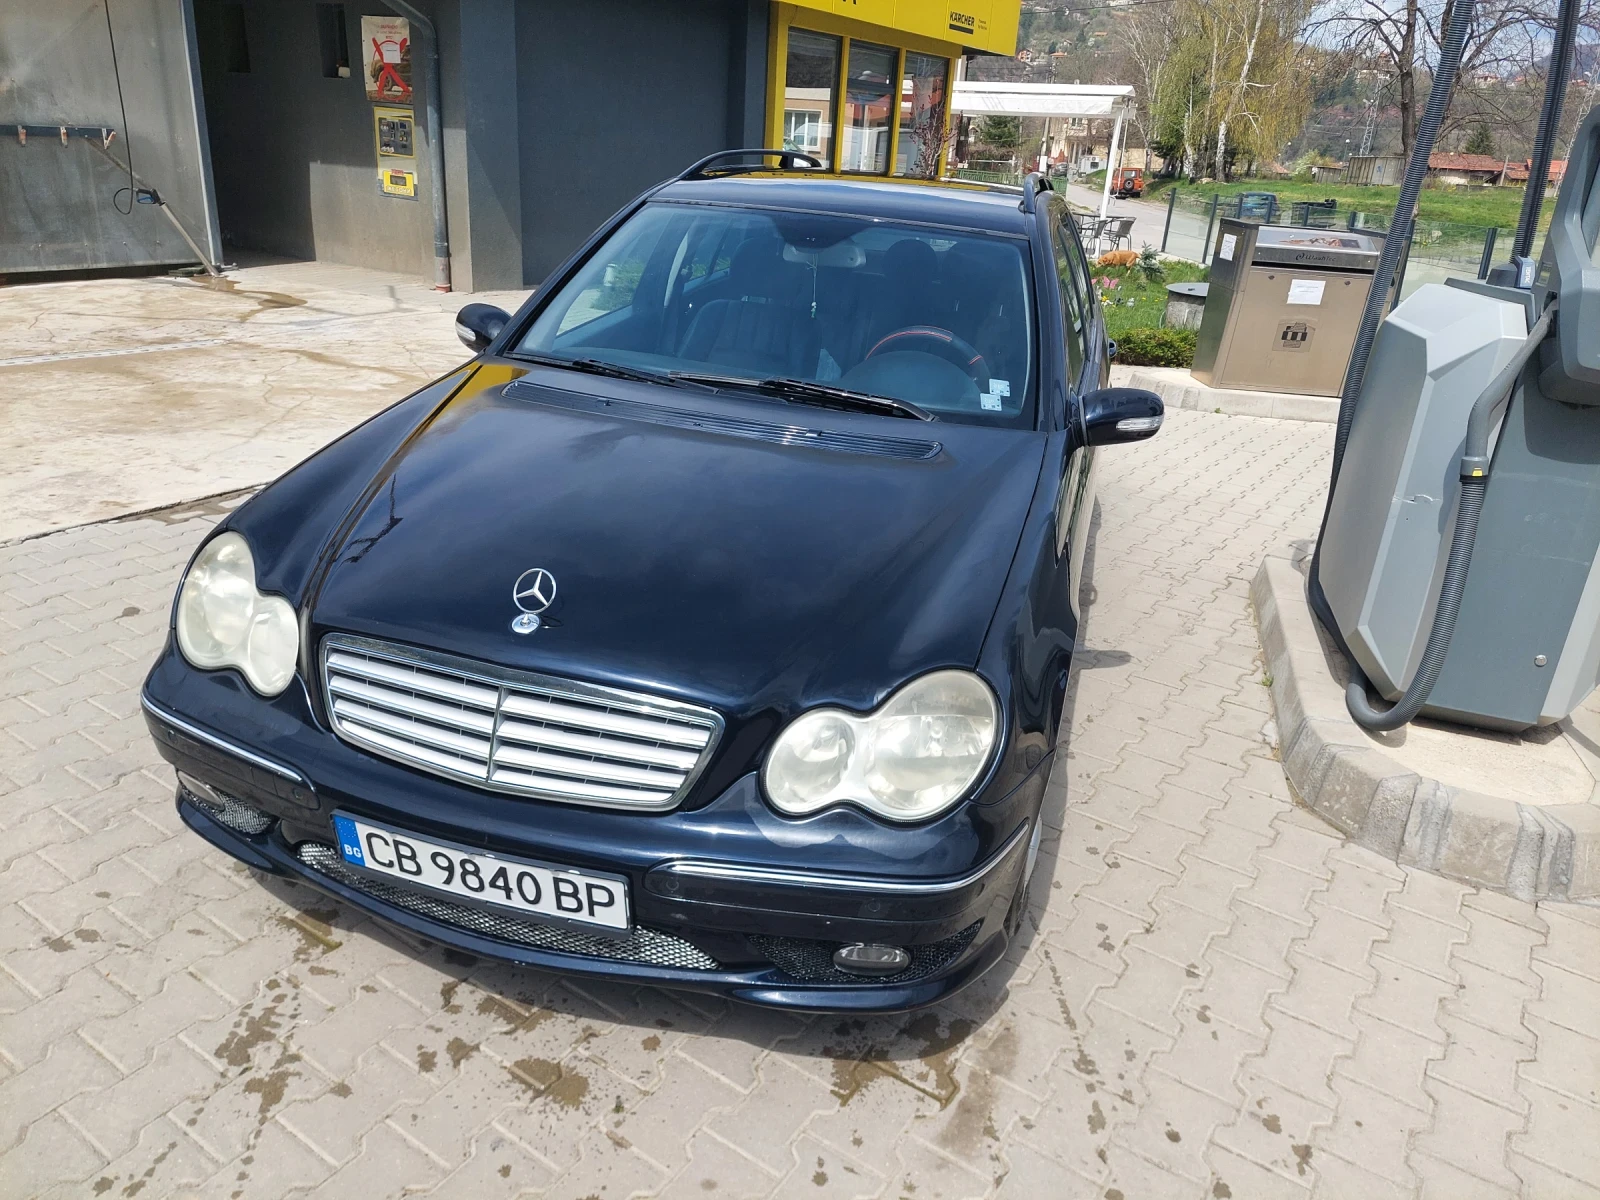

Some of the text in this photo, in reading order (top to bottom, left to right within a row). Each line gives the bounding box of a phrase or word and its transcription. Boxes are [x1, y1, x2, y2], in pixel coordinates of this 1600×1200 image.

[950, 11, 975, 26] KÄRCHER
[343, 843, 362, 859] BG
[365, 832, 615, 917] CB 9840 BP
